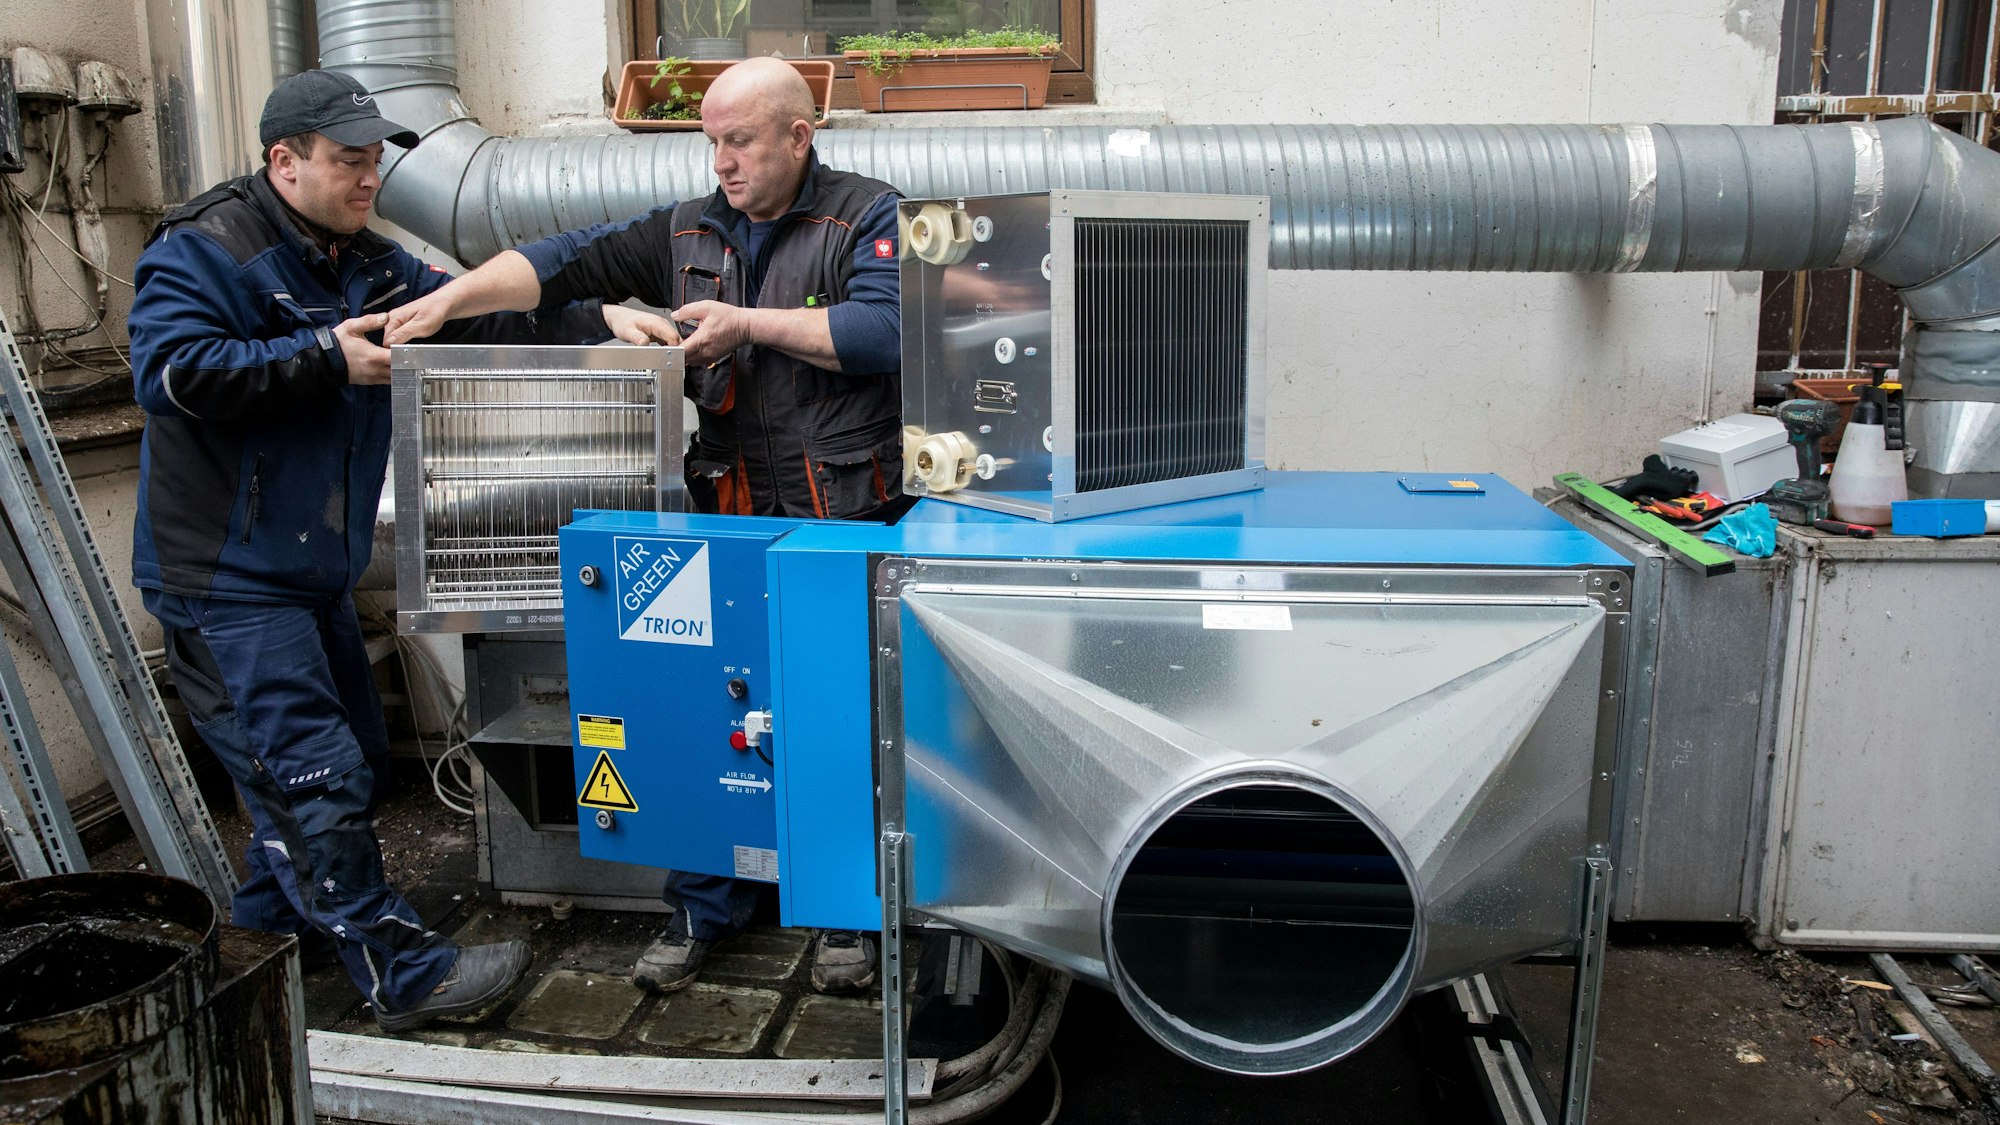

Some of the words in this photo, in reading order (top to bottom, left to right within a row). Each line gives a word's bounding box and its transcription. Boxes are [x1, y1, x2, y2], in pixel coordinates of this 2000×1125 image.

[620, 543, 651, 579] AIR
[624, 547, 681, 611] GREEN
[644, 617, 704, 636] TRION
[742, 667, 751, 675] ON
[727, 785, 743, 793] FLOW
